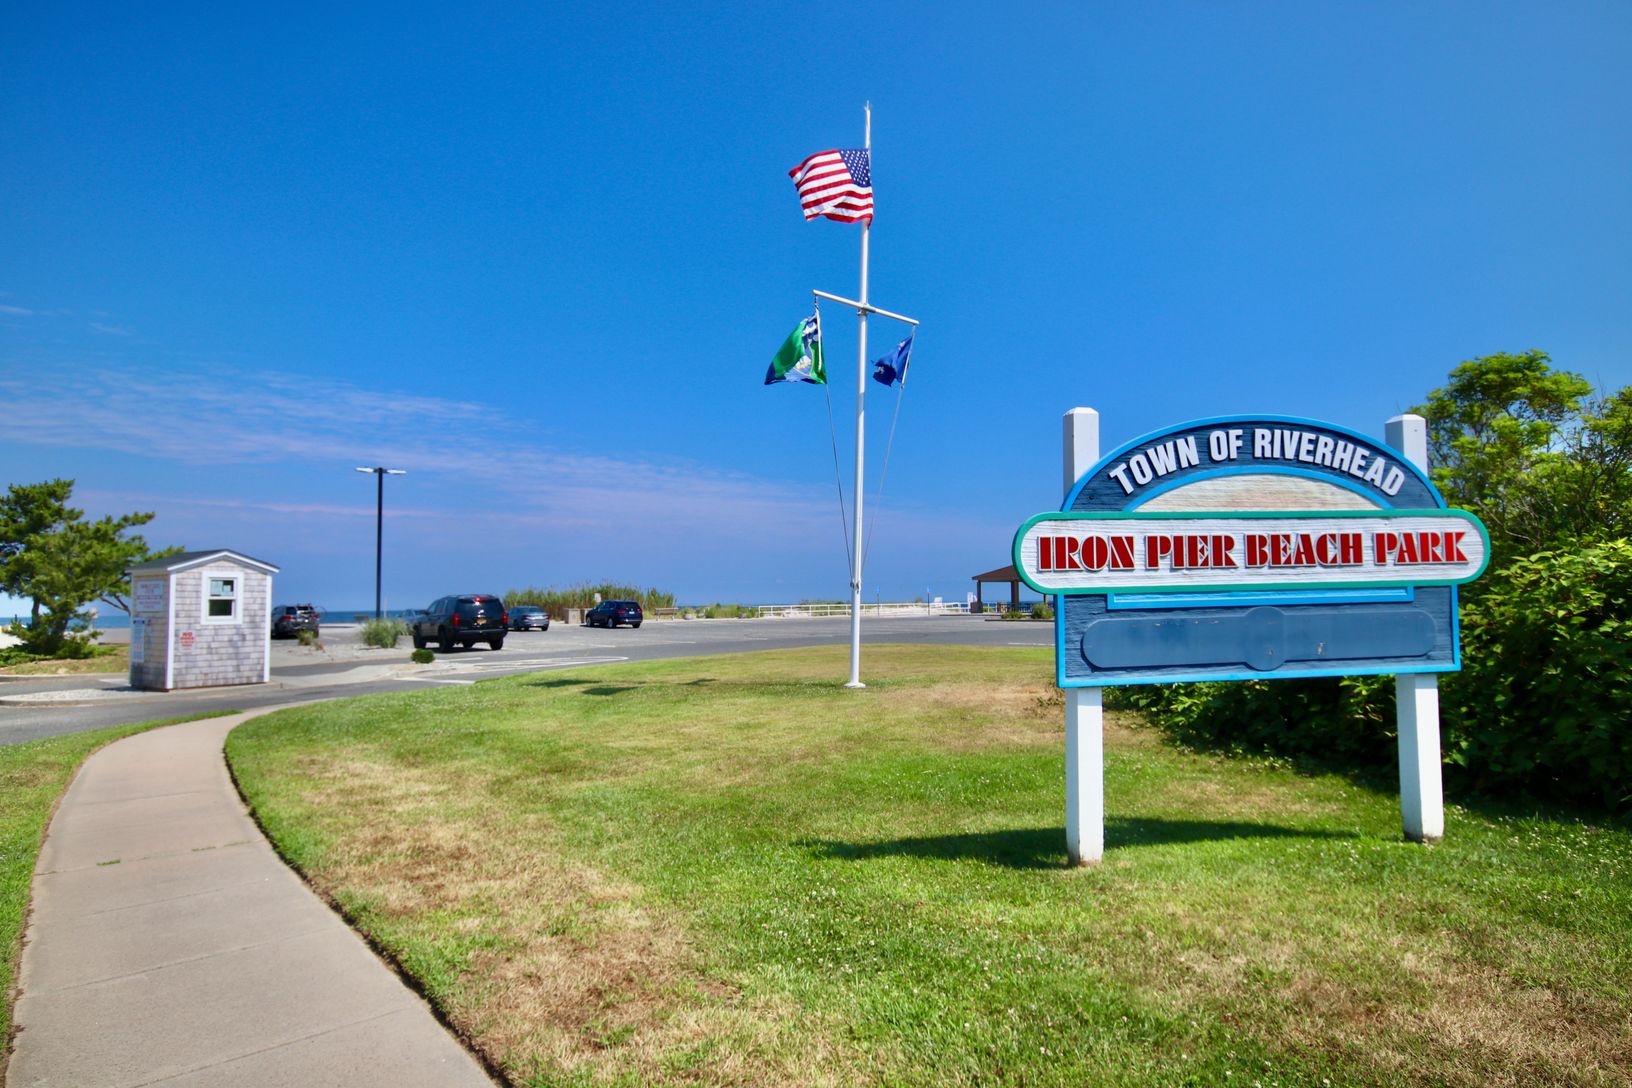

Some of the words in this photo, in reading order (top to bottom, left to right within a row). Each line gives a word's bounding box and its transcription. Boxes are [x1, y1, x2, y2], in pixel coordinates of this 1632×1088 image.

[1109, 437, 1199, 495] TOWN
[1209, 429, 1243, 461] OF
[1254, 428, 1404, 496] RIVERHEAD
[1038, 535, 1135, 571] IRON
[1145, 534, 1237, 569] PIER
[1245, 532, 1364, 567] BEACH
[1374, 531, 1469, 565] PARK
